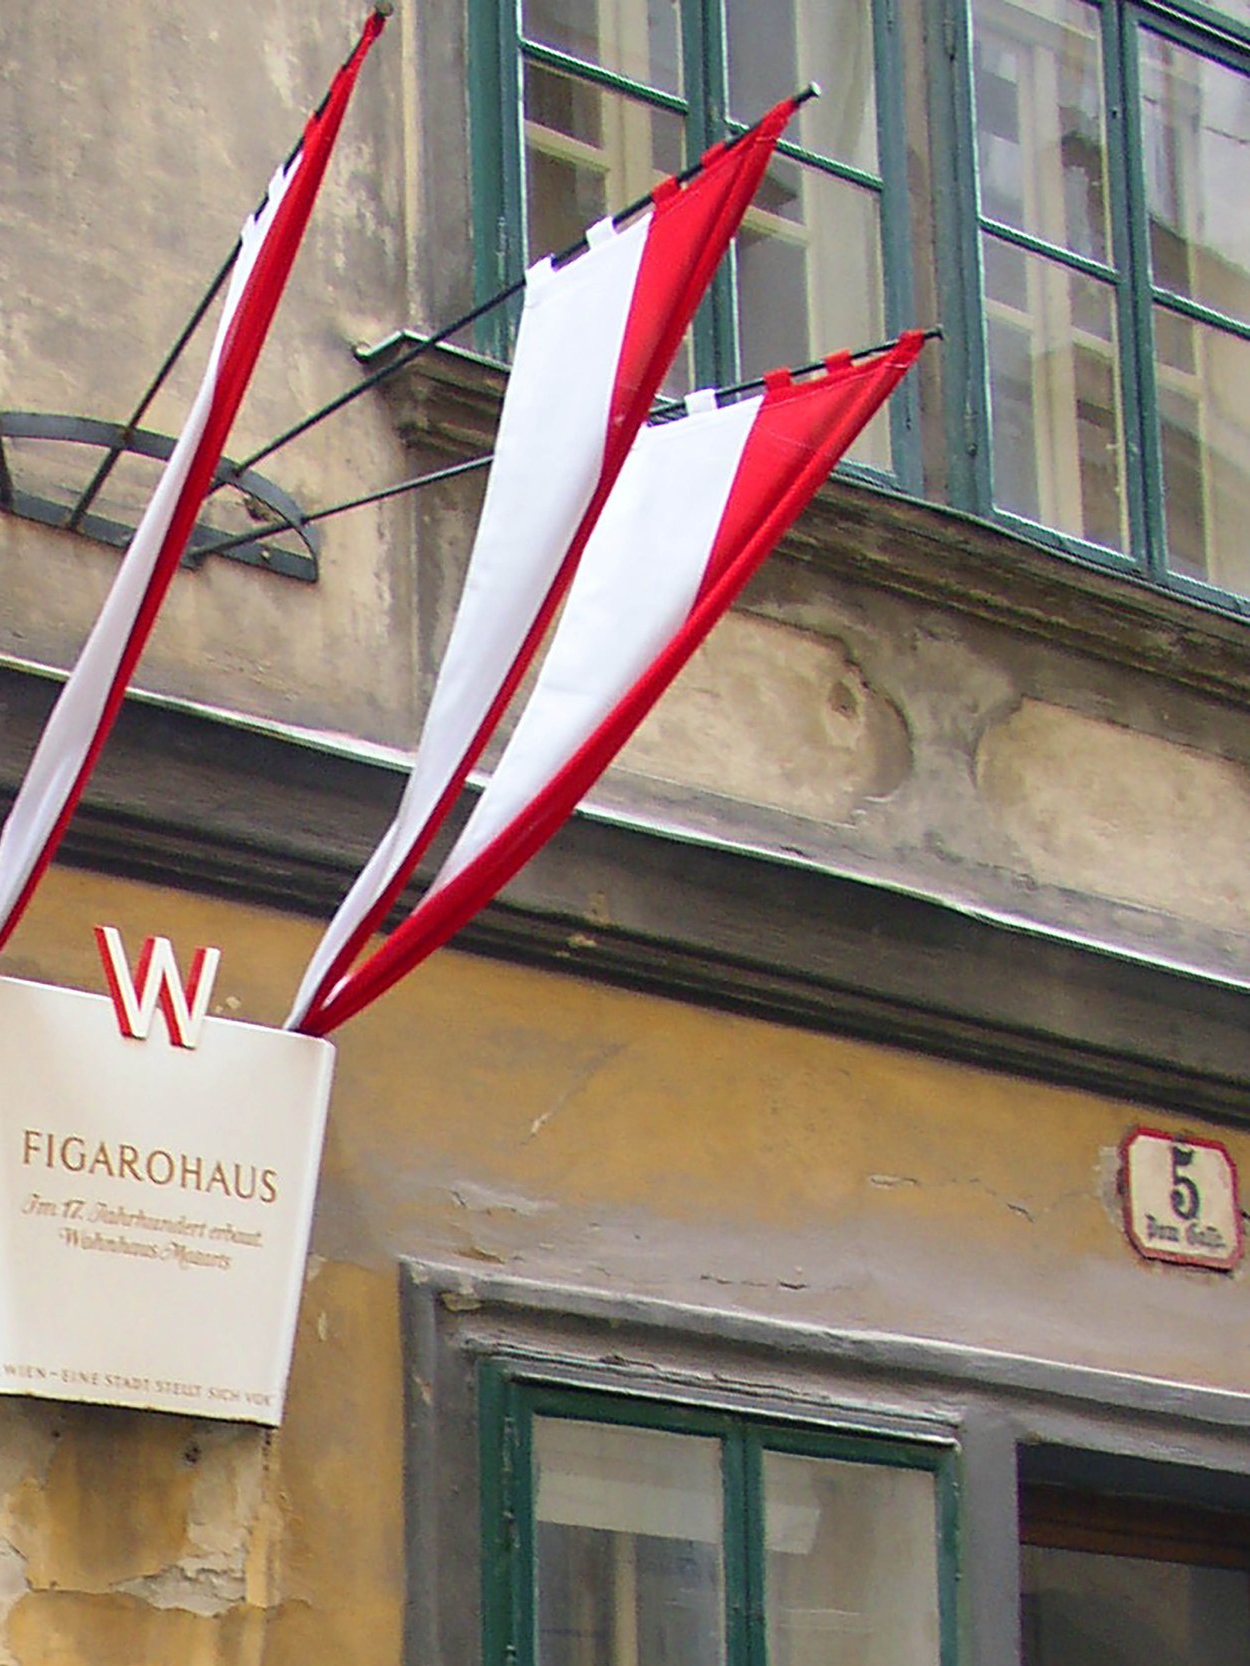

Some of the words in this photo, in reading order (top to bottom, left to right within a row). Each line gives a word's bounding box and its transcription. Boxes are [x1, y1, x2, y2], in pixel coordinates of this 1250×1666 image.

[93, 925, 221, 1051] W
[22, 1130, 278, 1204] FIGAROHAUS
[1170, 1145, 1200, 1220] 5
